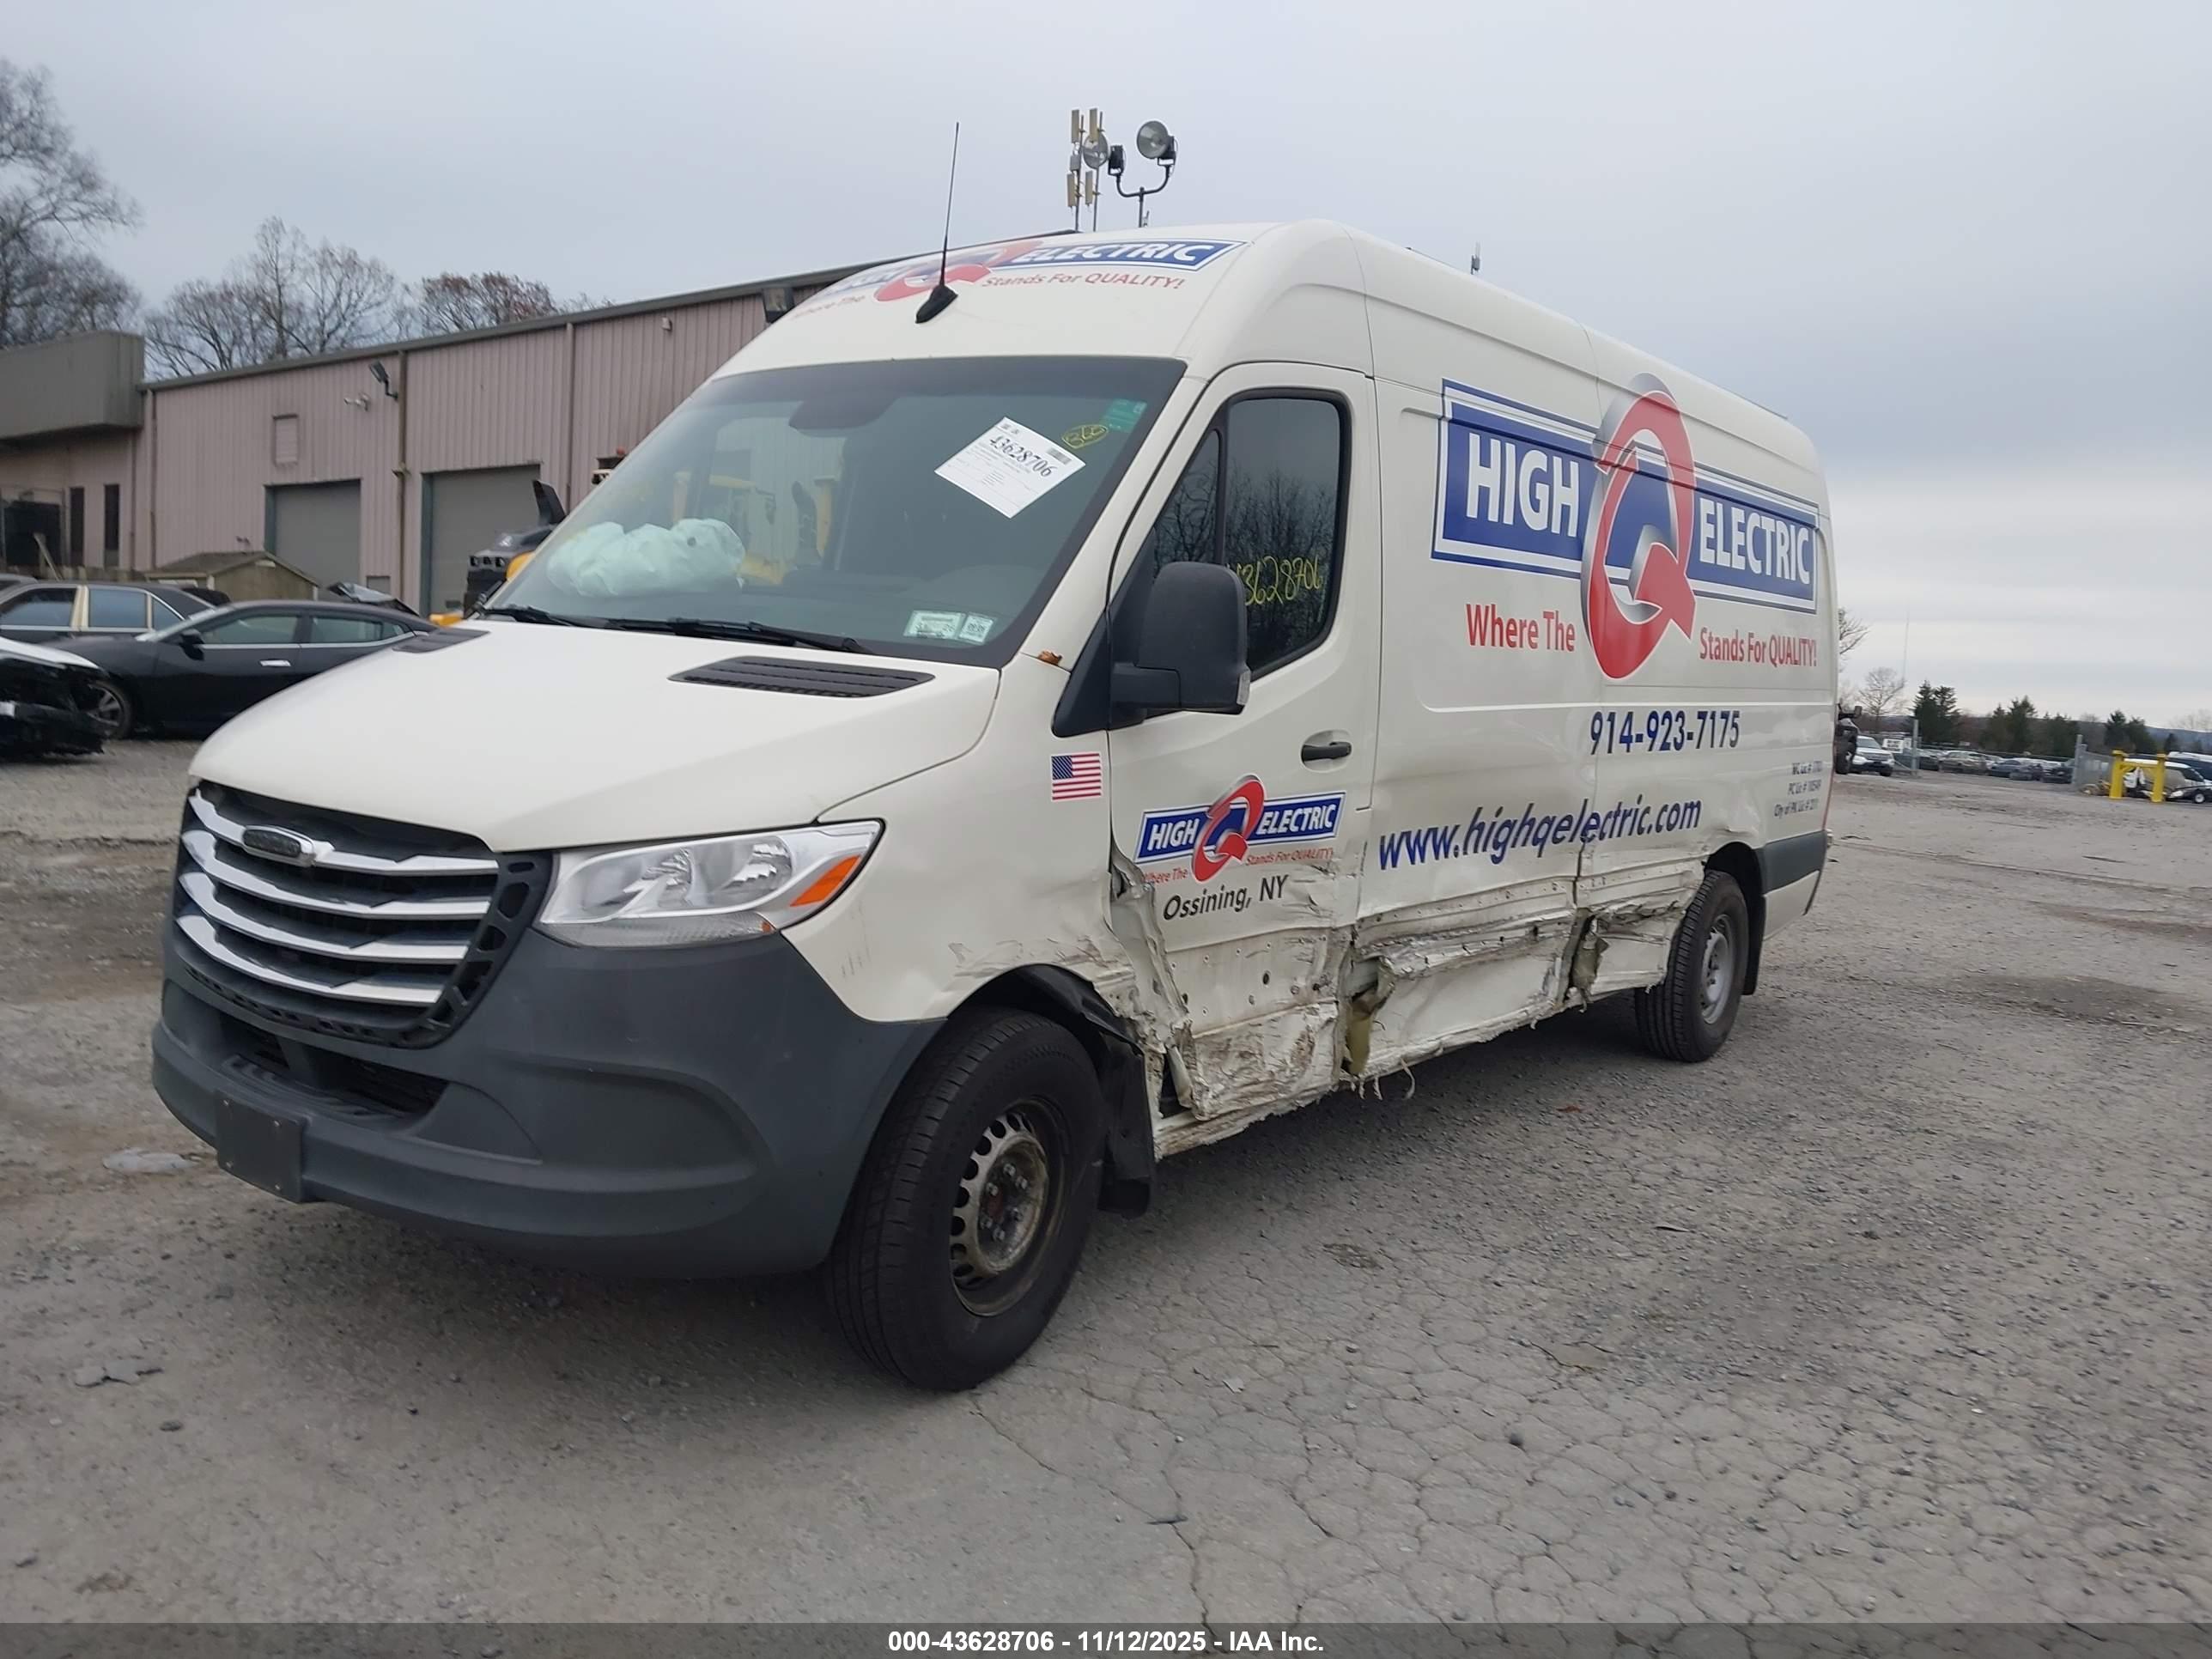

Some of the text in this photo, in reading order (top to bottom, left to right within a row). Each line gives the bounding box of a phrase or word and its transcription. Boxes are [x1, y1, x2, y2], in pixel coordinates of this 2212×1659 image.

[1014, 242, 1212, 263] ELECTRIC
[981, 273, 1043, 289] Stands
[1049, 272, 1082, 284] For
[1085, 272, 1185, 289] QUALITY!
[989, 434, 1058, 477] 43628706
[1466, 432, 1580, 538] HIGH
[1698, 496, 1812, 585] ELECTRIC
[1465, 604, 1817, 667] Where The Stands For QUALITY!
[1589, 710, 1741, 755] 914-923-7175
[1146, 817, 1200, 851] HIGH
[1255, 804, 1336, 836] ELECTRIC
[1378, 793, 1702, 871] www.highqelectric.com
[1163, 874, 1290, 921] Ossining, NY
